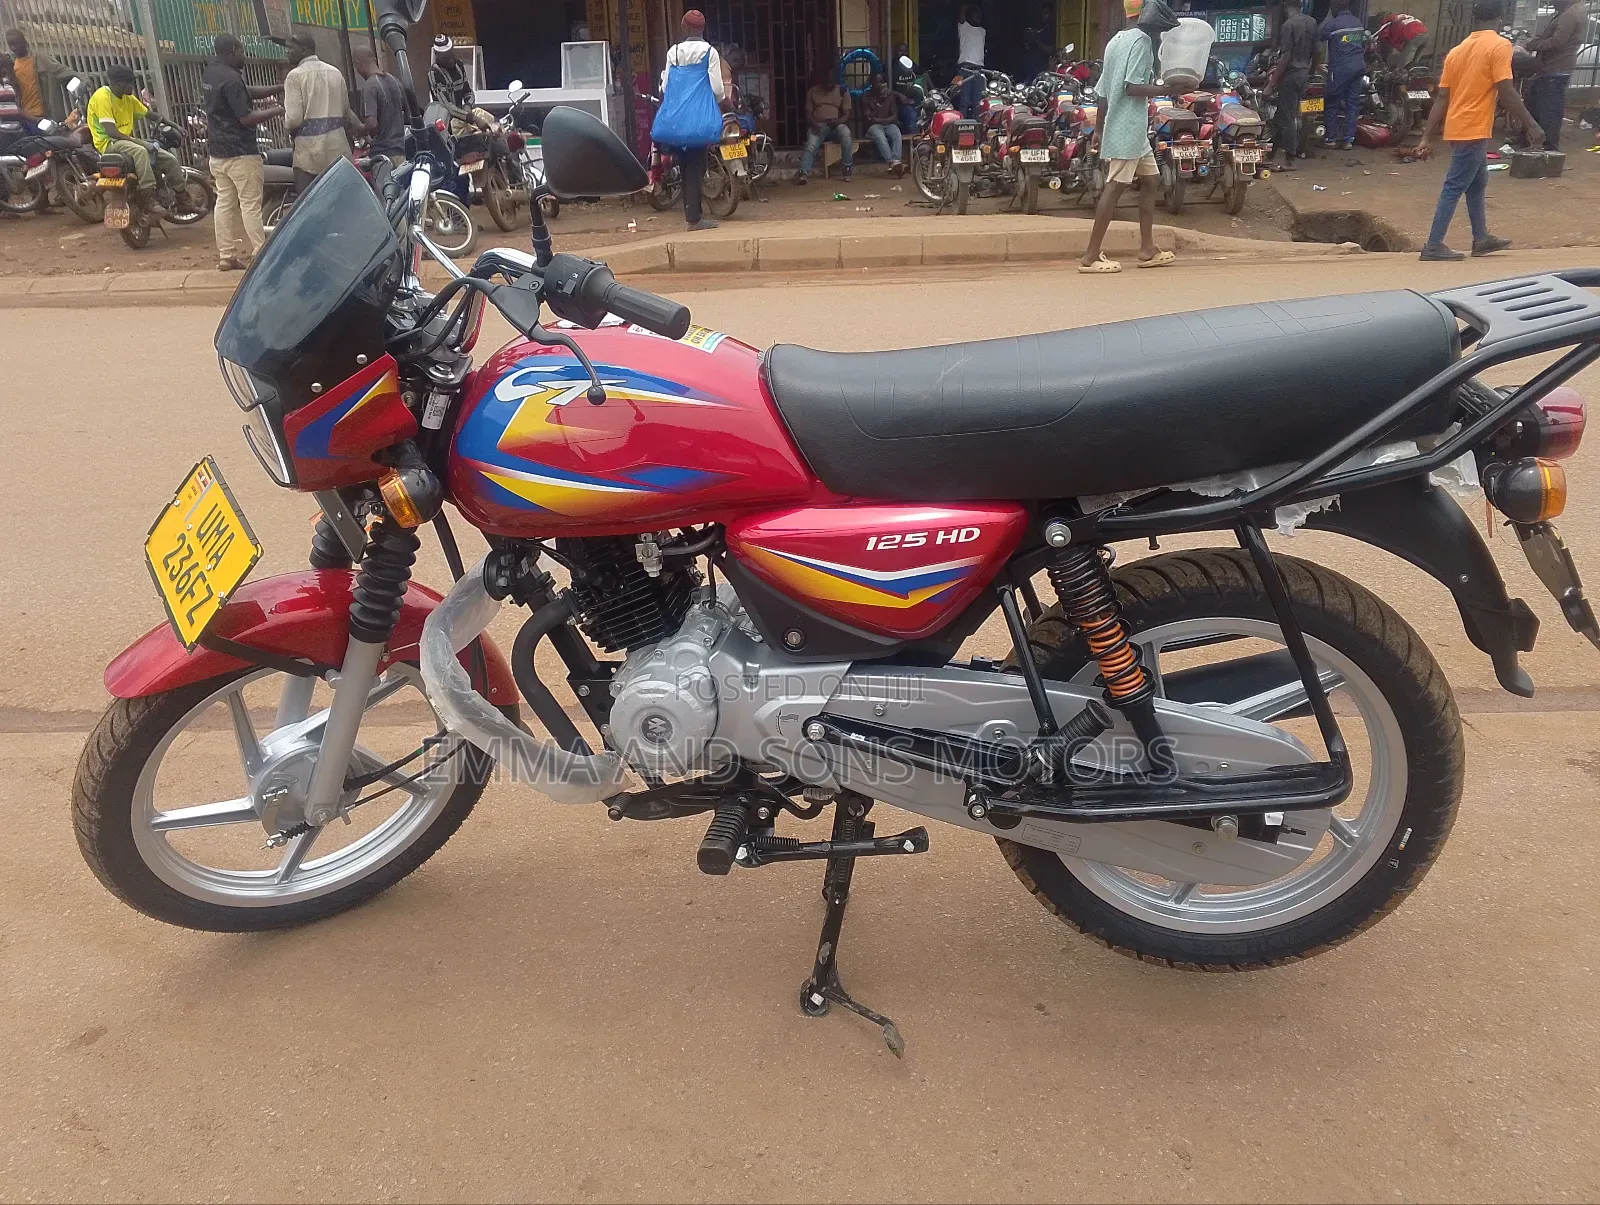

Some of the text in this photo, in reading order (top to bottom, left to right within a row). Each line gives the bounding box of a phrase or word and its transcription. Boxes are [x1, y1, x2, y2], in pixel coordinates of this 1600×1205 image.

[106, 217, 128, 226] GOD
[196, 502, 235, 571] UMA
[865, 527, 981, 551] 125 HD
[162, 532, 214, 627] 236FZ
